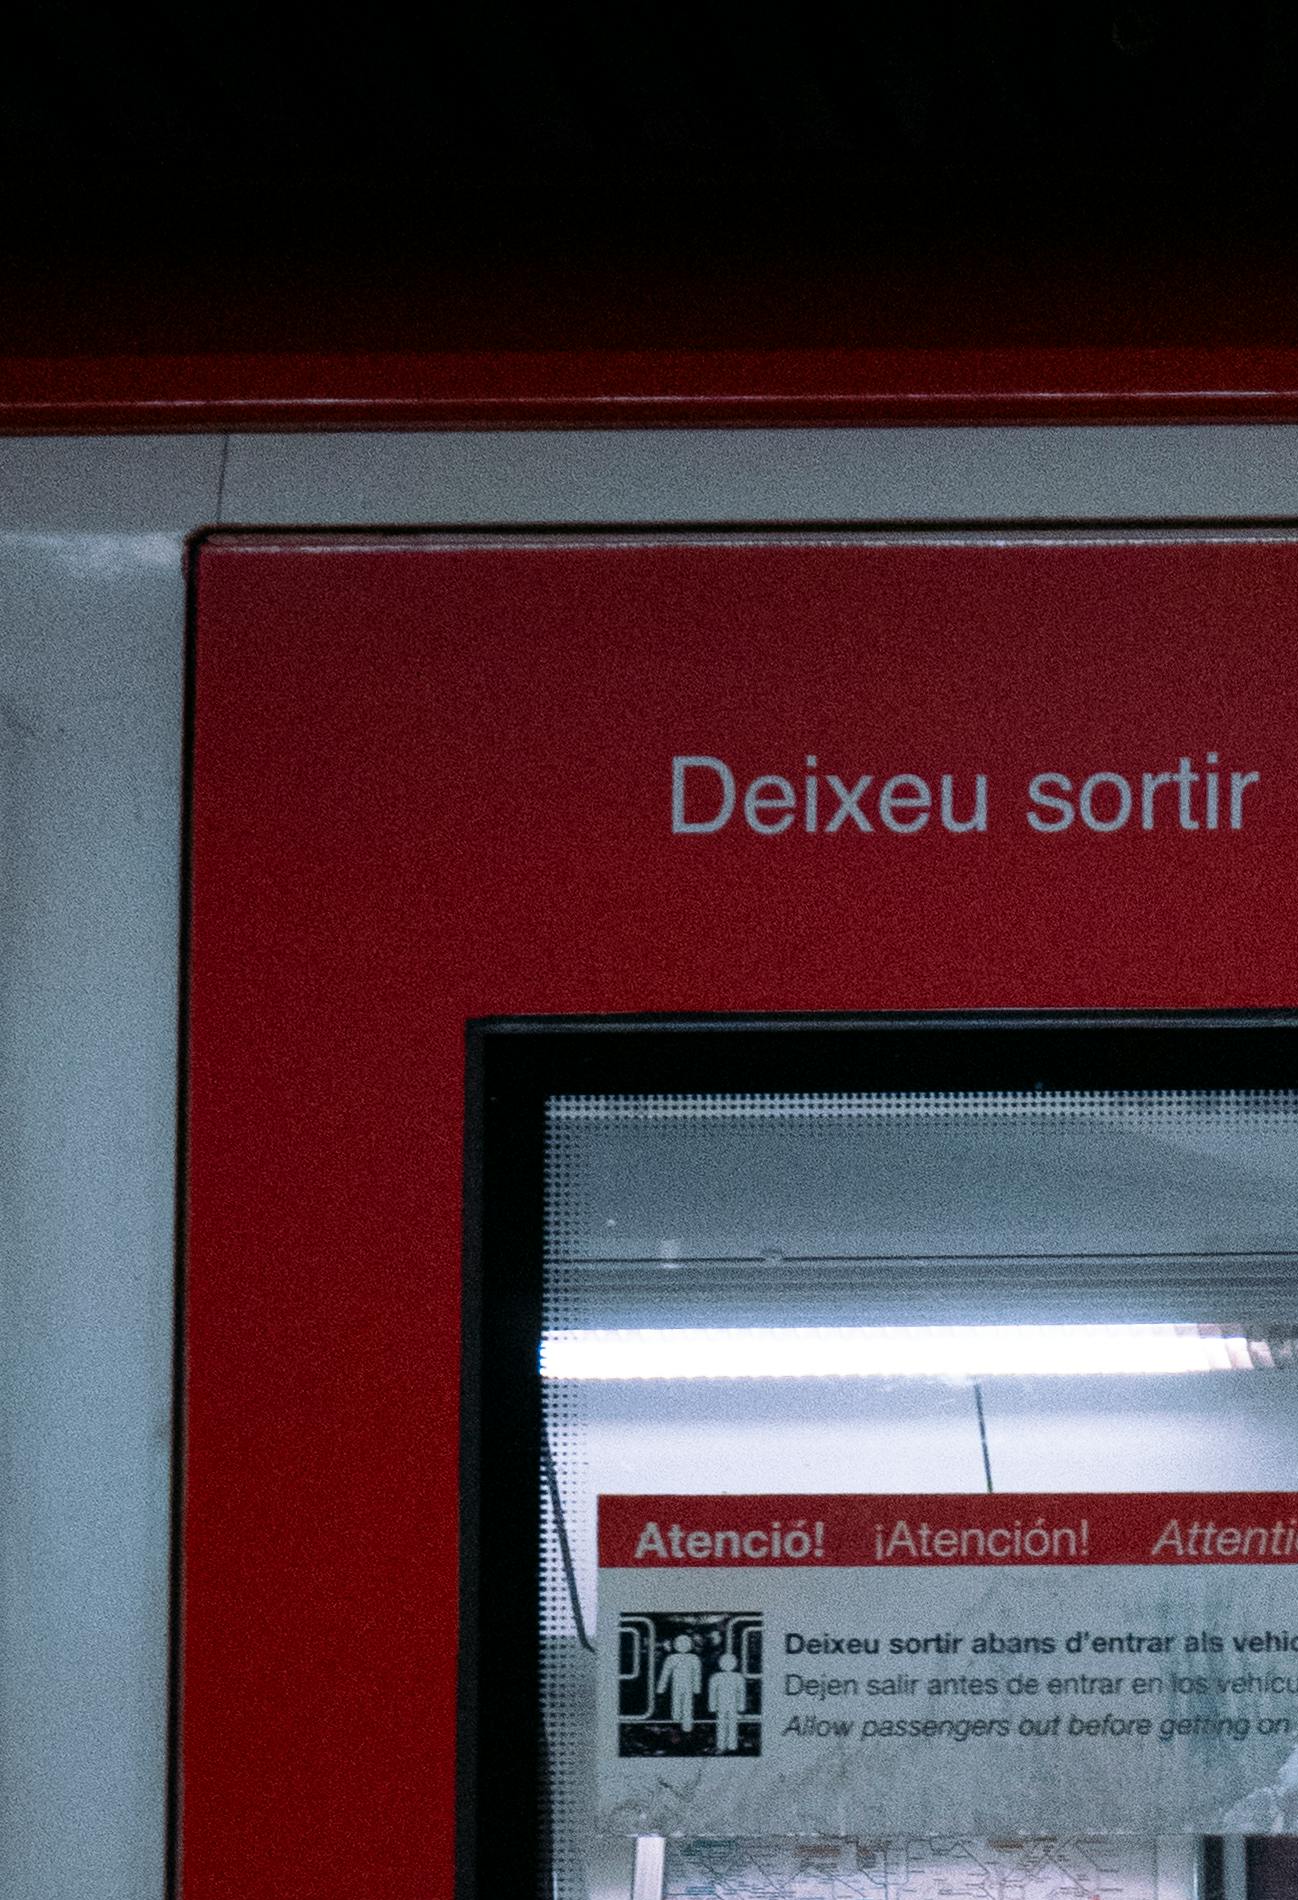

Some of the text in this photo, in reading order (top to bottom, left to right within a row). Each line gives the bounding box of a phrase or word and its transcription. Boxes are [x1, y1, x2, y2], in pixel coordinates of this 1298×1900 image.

[671, 752, 1260, 836] Deixeu sortir
[633, 1519, 825, 1559] Atenció!
[875, 1518, 1091, 1560] ¡Atención!
[784, 1632, 880, 1656] Deixeu
[889, 1631, 963, 1655] sortir
[971, 1631, 1056, 1654] abans
[1065, 1631, 1176, 1653] d'entrar
[1184, 1630, 1225, 1653] als
[785, 1673, 858, 1701] Dejen
[865, 1674, 919, 1696] salir
[927, 1674, 999, 1696] antes
[1006, 1673, 1040, 1695] de
[1046, 1674, 1124, 1695] entrar
[1131, 1677, 1163, 1694] en
[1172, 1673, 1209, 1694] los
[782, 1714, 853, 1737] Allow
[859, 1717, 1010, 1742] passengers
[1018, 1715, 1062, 1737] out
[1068, 1714, 1152, 1737] before
[1256, 1717, 1290, 1736] on
